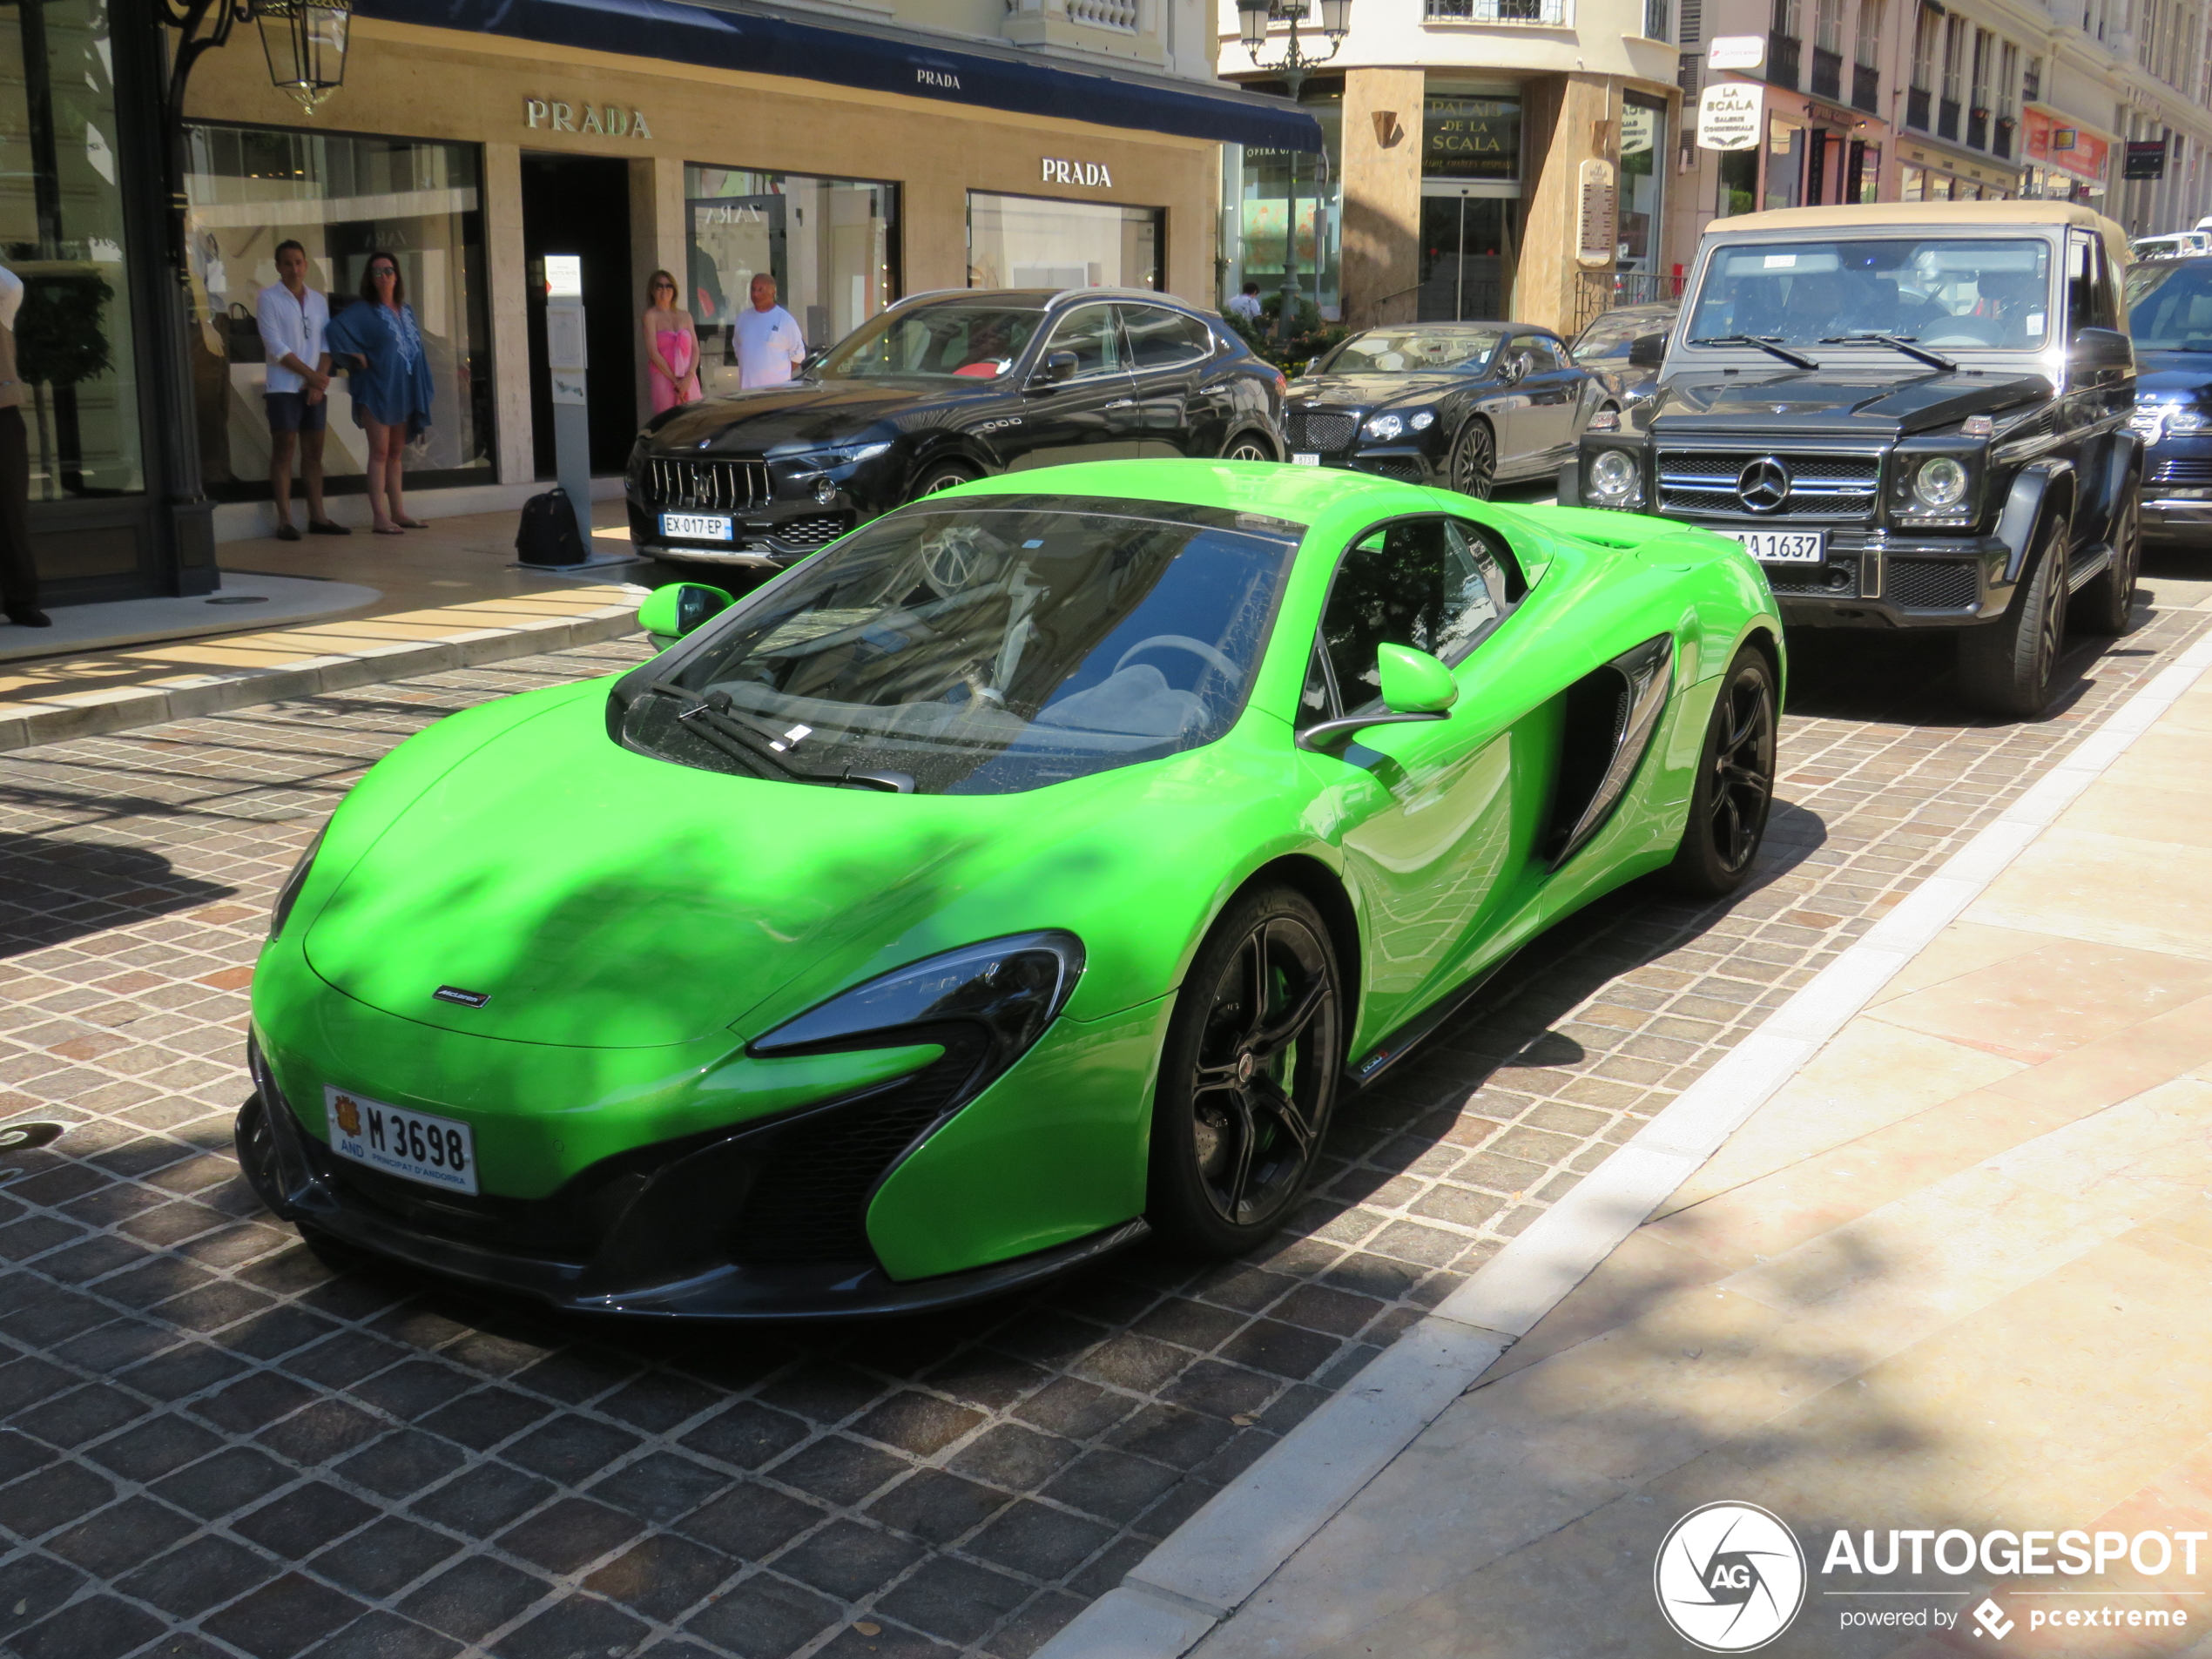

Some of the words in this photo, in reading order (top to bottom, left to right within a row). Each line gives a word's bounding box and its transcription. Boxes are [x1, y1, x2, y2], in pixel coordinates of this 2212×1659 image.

[917, 69, 961, 90] PRADA
[1723, 87, 1738, 98] LA
[1432, 101, 1503, 118] PALAIS
[1706, 99, 1754, 111] SCALA
[526, 98, 652, 139] PRADA
[1446, 120, 1463, 132] DE
[1469, 121, 1487, 132] LA
[1432, 135, 1501, 152] SCALA
[1246, 147, 1277, 158] OPERA
[1042, 158, 1112, 188] PRADA
[665, 517, 722, 534] EX-017-EP
[1766, 535, 1817, 558] 1637
[438, 989, 478, 1001] McLaren
[341, 1139, 365, 1158] AND
[372, 1152, 412, 1172] PRINCIPAT
[415, 1167, 466, 1185] D'ANDORRA
